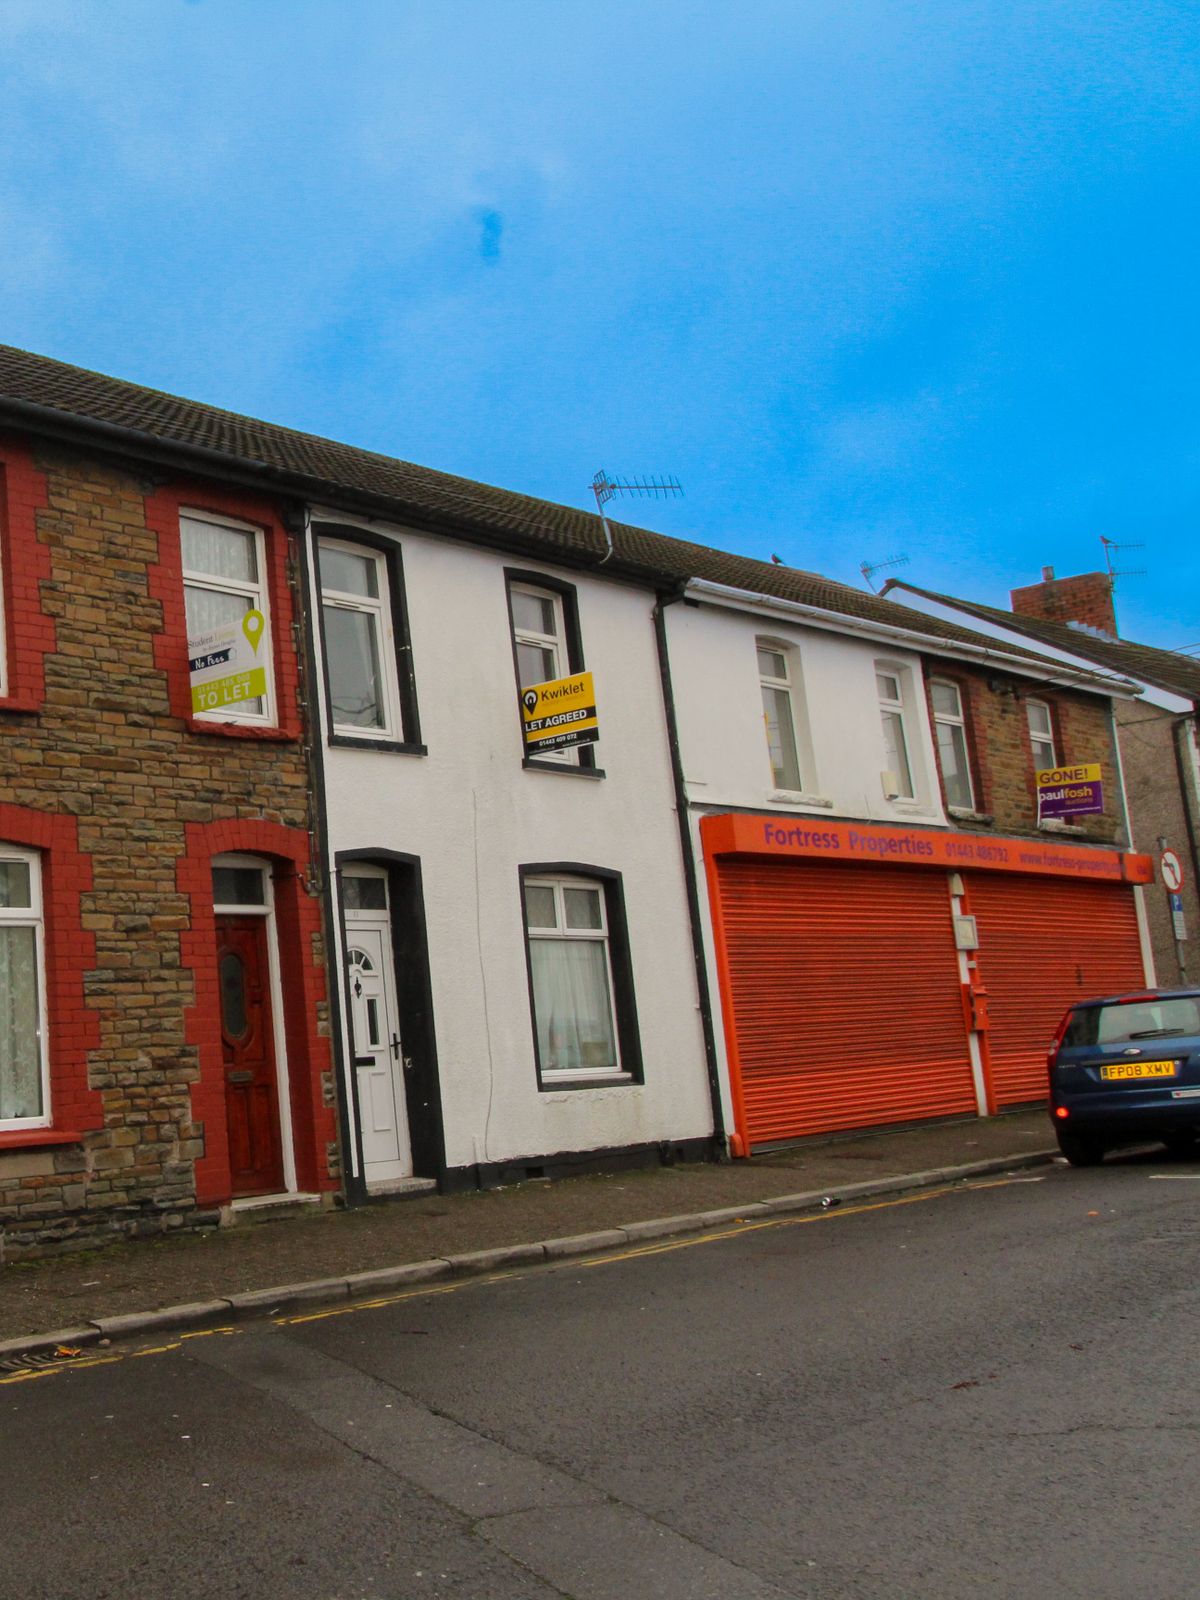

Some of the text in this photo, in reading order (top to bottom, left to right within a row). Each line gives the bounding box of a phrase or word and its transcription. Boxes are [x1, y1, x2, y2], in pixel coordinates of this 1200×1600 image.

[195, 654, 225, 670] No Fees
[198, 681, 250, 708] TO LET
[541, 682, 585, 701] Kwiklet
[525, 709, 587, 732] LET AGREED
[1039, 768, 1088, 784] GONE!
[763, 823, 840, 849] Fortress
[848, 831, 933, 857] Properties
[1109, 1063, 1170, 1077] FP08 XMV
